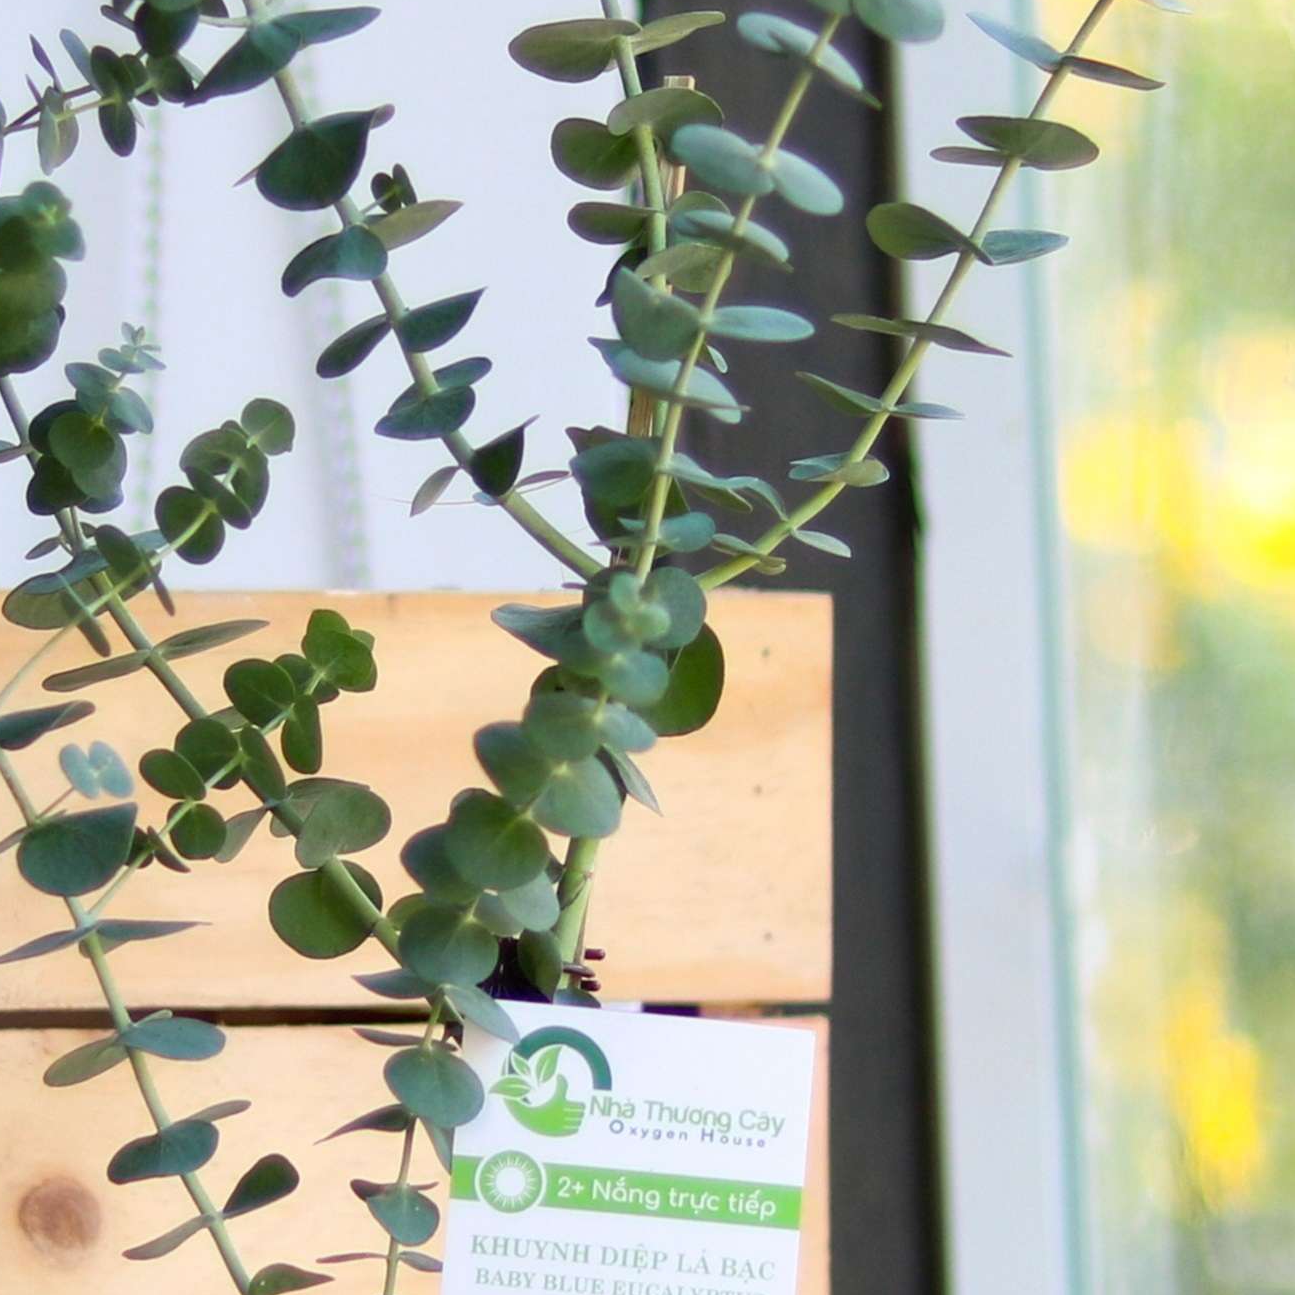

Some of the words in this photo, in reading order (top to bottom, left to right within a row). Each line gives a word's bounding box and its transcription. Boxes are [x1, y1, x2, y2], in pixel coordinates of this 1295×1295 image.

[589, 1096, 635, 1119] Nhà
[644, 1101, 732, 1133] Thương
[738, 1109, 785, 1137] Cây
[609, 1120, 688, 1142] Oxygen
[700, 1130, 766, 1148] House
[557, 1177, 584, 1198] 2+
[593, 1177, 660, 1210] Nắng
[669, 1186, 719, 1214] trực
[728, 1189, 776, 1220] tiếp
[471, 1234, 590, 1264] KHUYNH
[600, 1243, 668, 1275] DIỆP
[677, 1250, 710, 1275] LÁ
[720, 1258, 775, 1284] BẠC
[475, 1269, 536, 1289] BABY
[543, 1275, 605, 1295] BLUE
